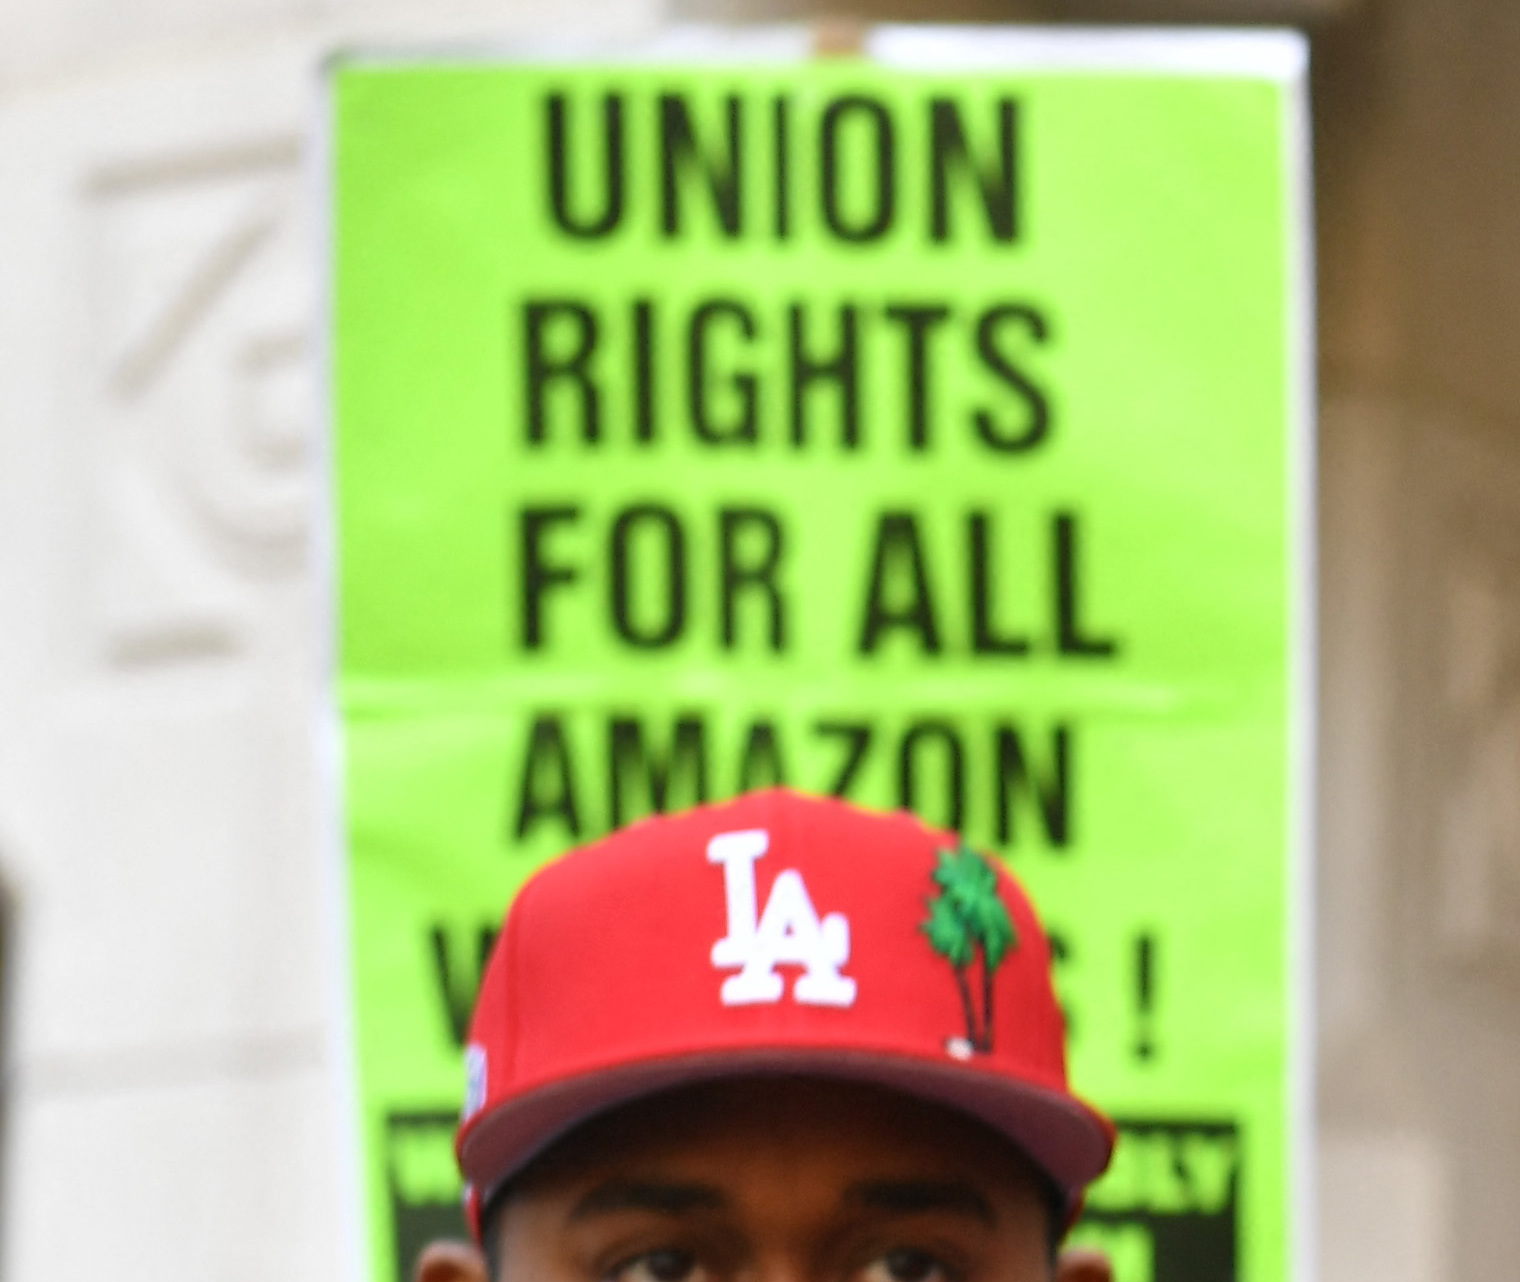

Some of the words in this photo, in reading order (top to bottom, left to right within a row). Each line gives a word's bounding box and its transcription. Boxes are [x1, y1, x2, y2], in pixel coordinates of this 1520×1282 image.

[538, 88, 1024, 248] UNION
[516, 294, 1056, 459] RIGHTS
[514, 499, 791, 656] FOR
[853, 506, 1122, 663] ALL
[511, 710, 1075, 851] AMAZON
[706, 829, 857, 1006] LA
